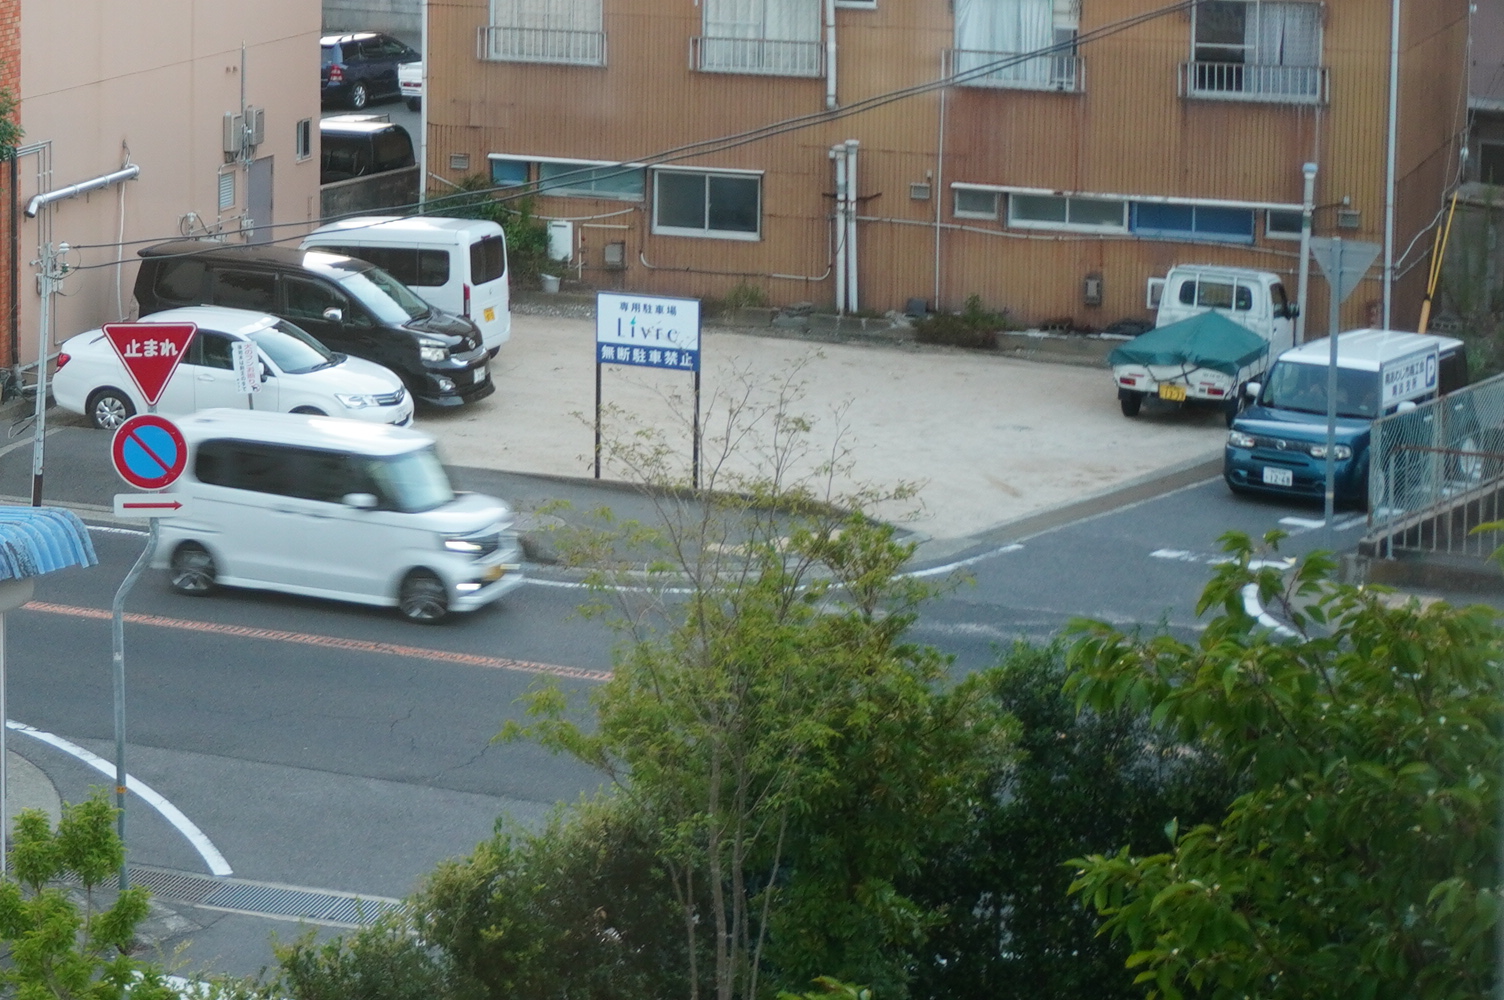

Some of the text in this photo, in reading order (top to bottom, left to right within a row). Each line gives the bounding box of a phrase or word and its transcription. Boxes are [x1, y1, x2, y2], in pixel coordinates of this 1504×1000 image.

[619, 301, 678, 316] 専用駐車場
[123, 338, 179, 358] 止まれ
[601, 345, 694, 368] 無断駐車禁止
